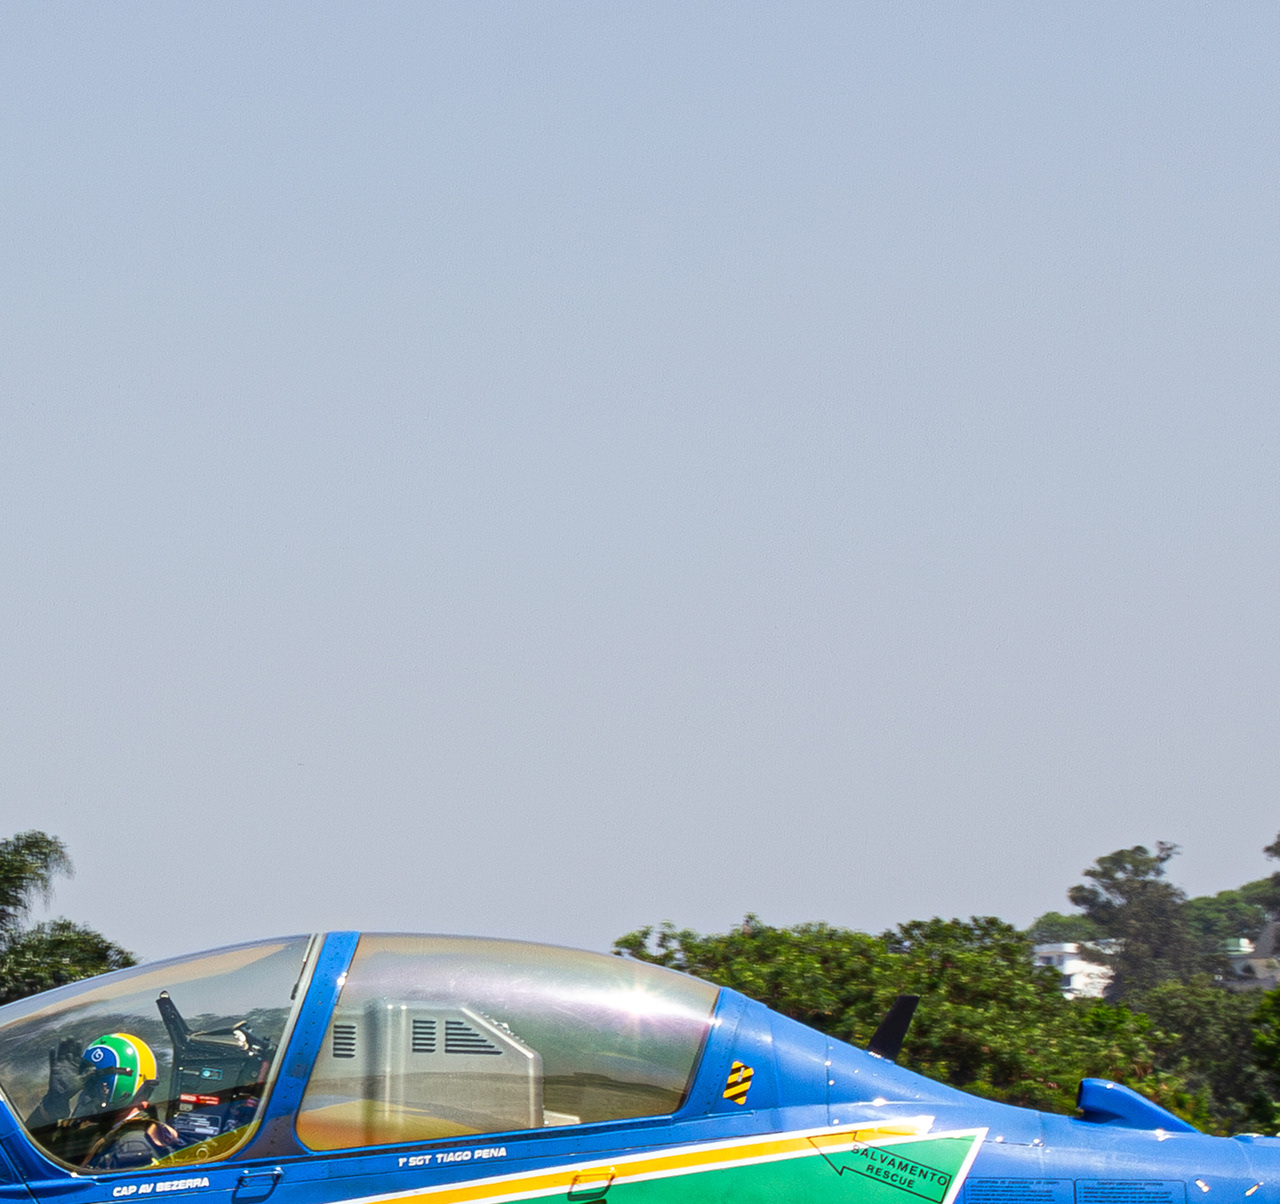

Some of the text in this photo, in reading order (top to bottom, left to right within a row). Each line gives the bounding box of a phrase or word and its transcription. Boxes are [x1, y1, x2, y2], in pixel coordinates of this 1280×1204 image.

[408, 1155, 432, 1167] SGT
[436, 1151, 472, 1163] TIAGO
[474, 1147, 507, 1159] PENA
[851, 1144, 948, 1187] SALVAMENTO
[113, 1177, 209, 1197] CAP AV BEZERRA
[866, 1164, 915, 1189] RESCUE
